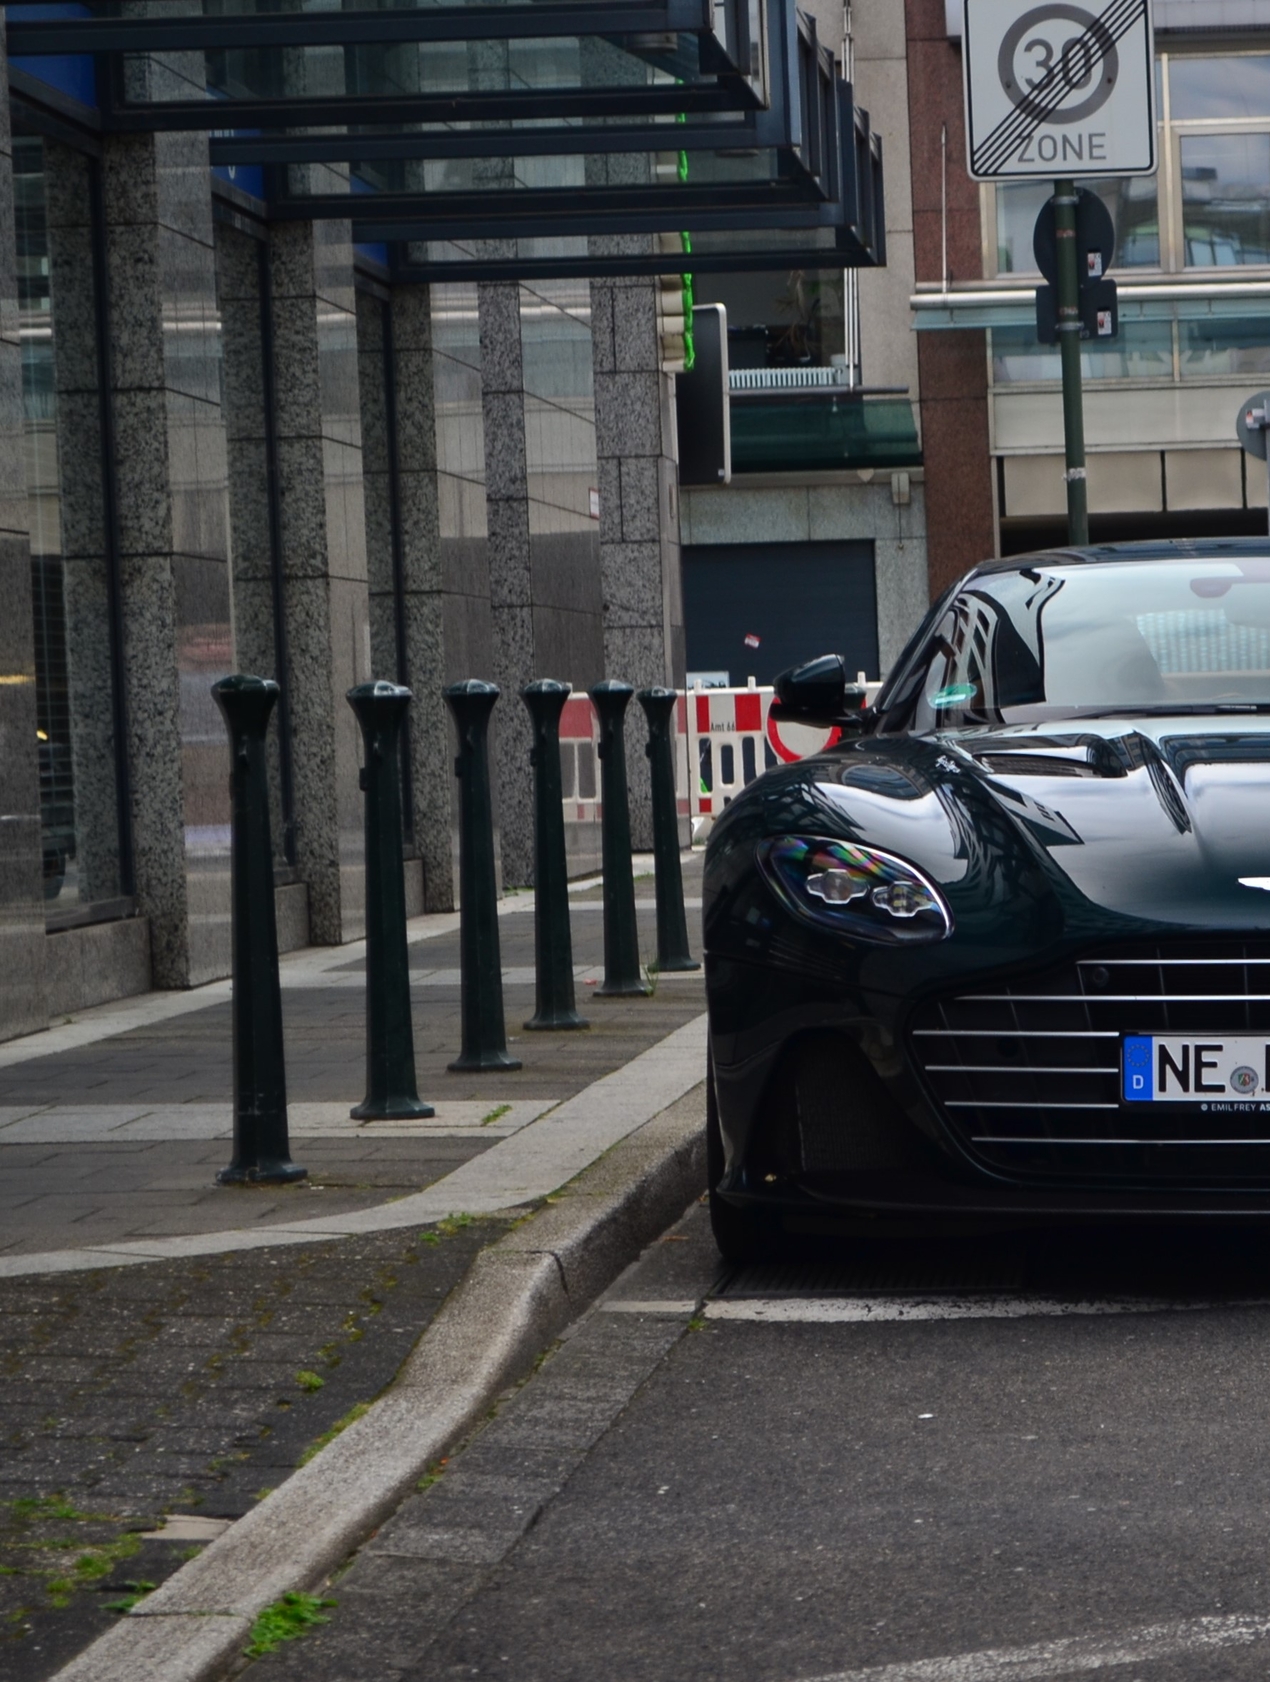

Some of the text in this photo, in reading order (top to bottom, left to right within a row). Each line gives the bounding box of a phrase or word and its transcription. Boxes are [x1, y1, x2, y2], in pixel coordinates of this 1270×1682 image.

[1023, 37, 1092, 90] 30
[1018, 132, 1107, 163] ZONE
[711, 722, 725, 732] Amt
[1133, 1075, 1144, 1090] D
[1158, 1044, 1226, 1093] NE
